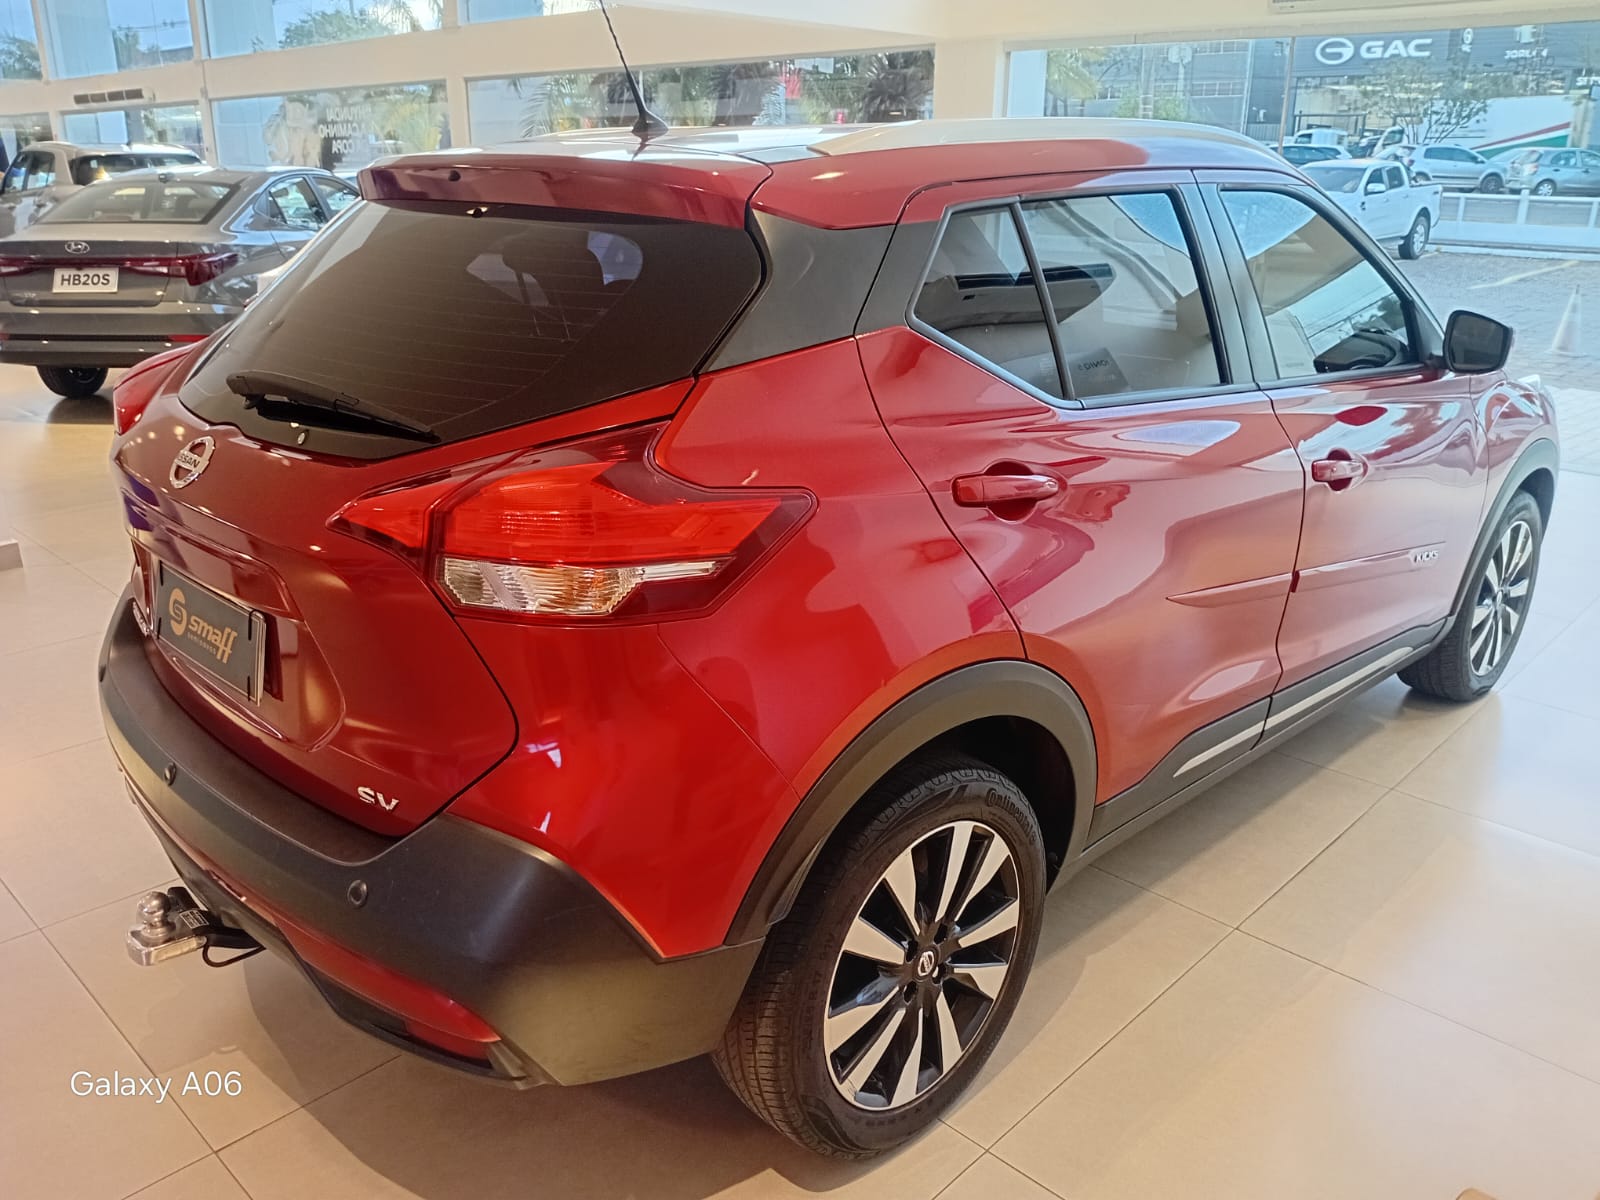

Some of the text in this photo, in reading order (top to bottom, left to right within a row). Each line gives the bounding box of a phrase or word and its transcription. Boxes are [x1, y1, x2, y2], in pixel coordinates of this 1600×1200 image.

[1360, 38, 1432, 58] GAC
[60, 273, 111, 287] HB20S
[188, 615, 238, 665] smaff
[357, 786, 399, 810] SV
